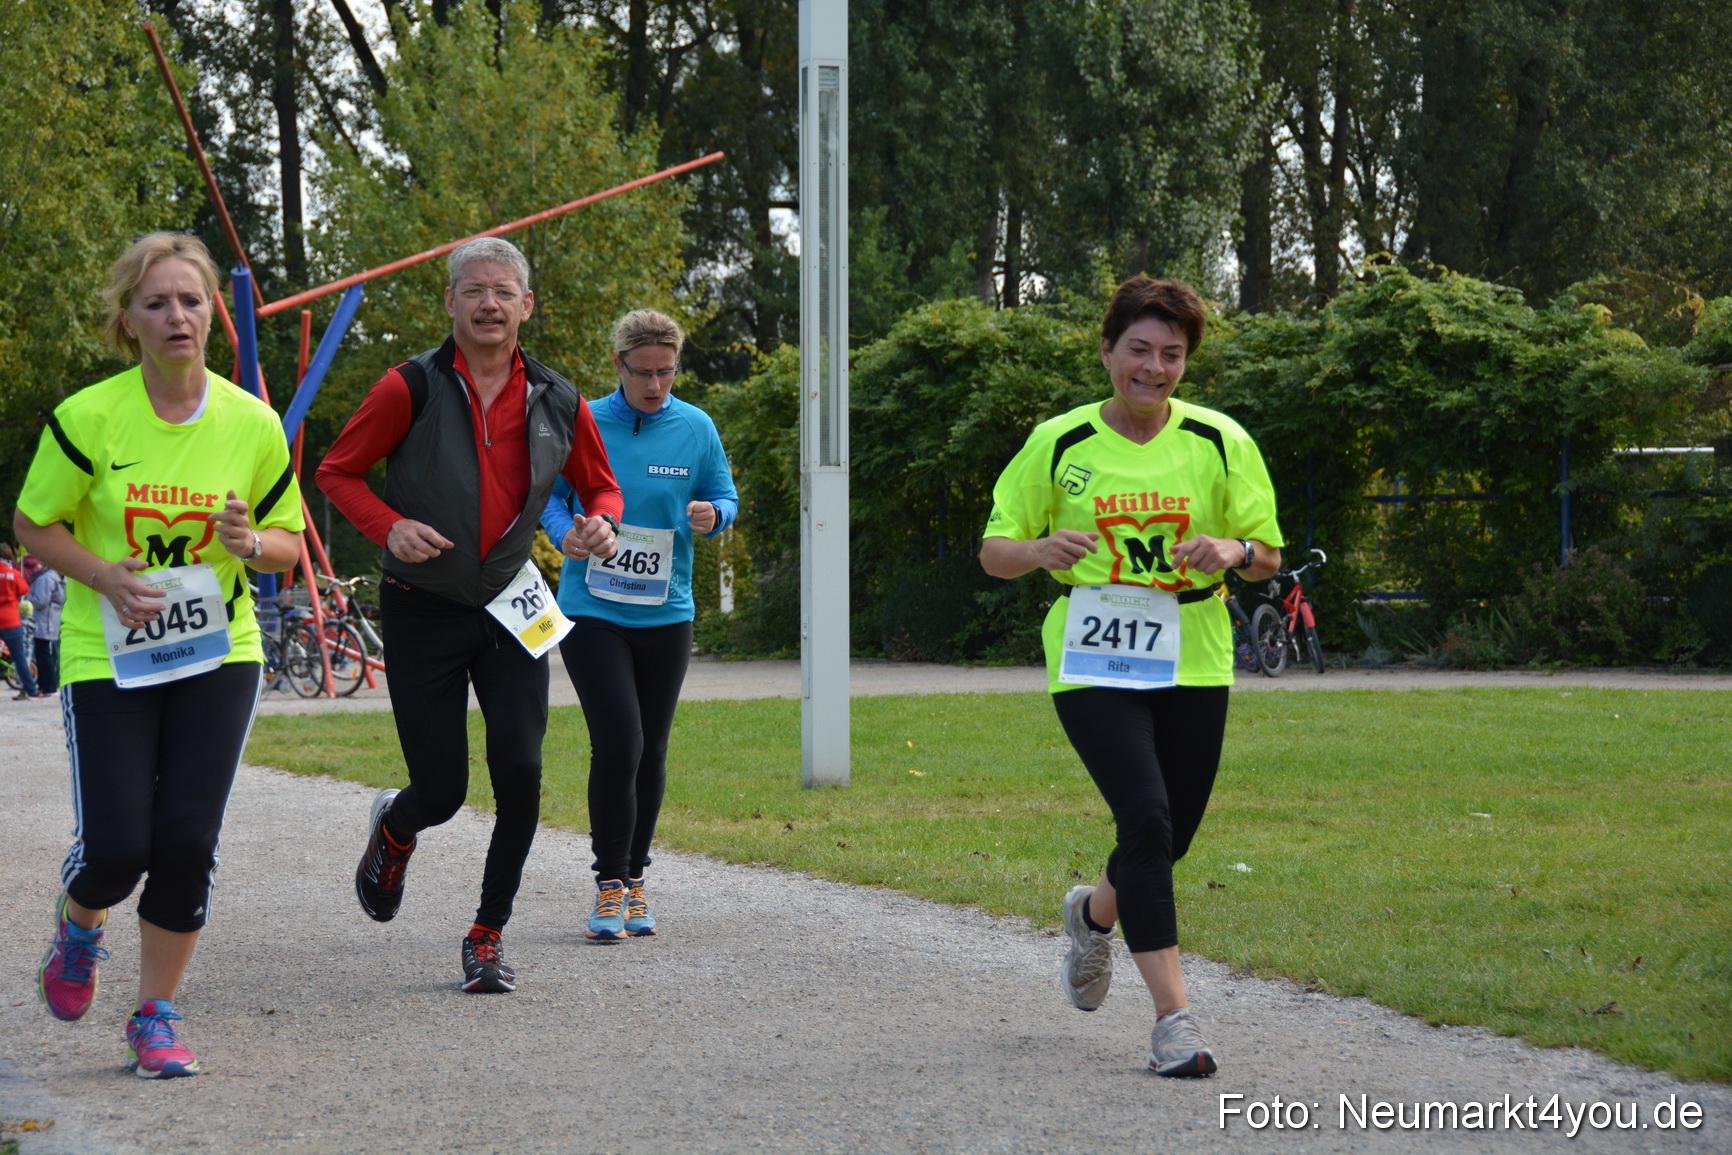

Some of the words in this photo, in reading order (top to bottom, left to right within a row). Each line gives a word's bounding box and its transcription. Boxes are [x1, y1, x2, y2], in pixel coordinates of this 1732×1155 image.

[647, 465, 690, 477] BOCK
[124, 482, 219, 508] Müller
[1092, 491, 1191, 517] Müller
[145, 534, 191, 568] M
[1123, 534, 1174, 575] M
[145, 577, 183, 589] OCK
[609, 577, 647, 591] Christina
[1111, 594, 1150, 607] BOCK
[1080, 615, 1163, 652] 2417
[150, 646, 196, 666] Monika
[1107, 660, 1131, 673] Rita
